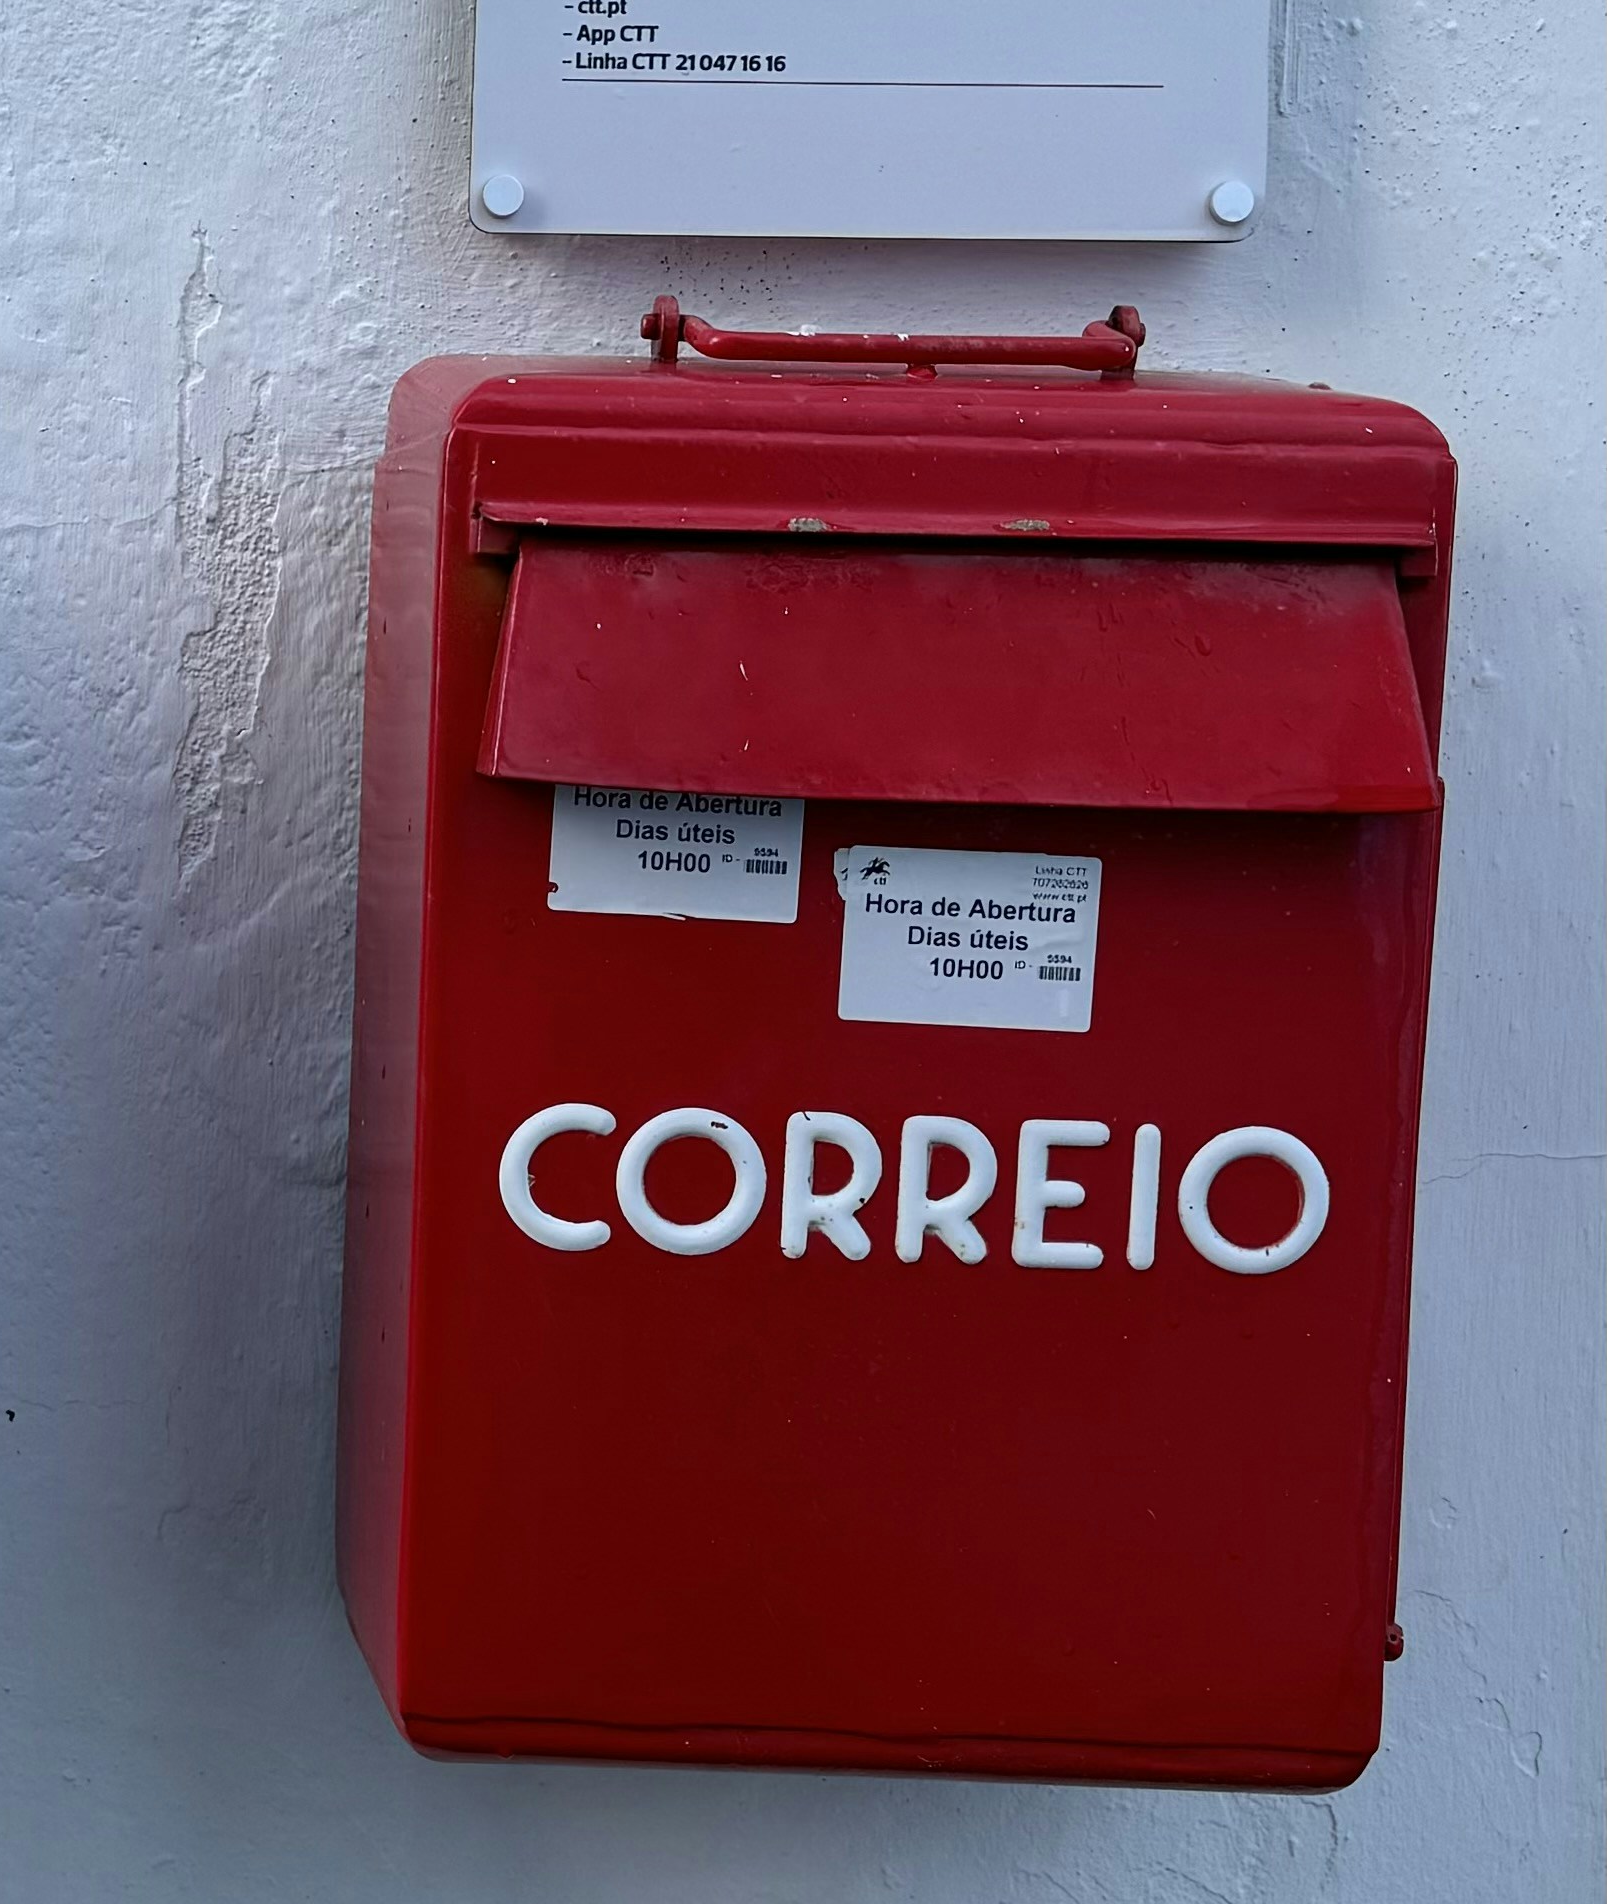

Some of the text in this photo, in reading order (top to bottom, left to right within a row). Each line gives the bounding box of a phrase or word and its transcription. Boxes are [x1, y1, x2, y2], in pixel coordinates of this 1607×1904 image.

[577, 25, 615, 45] App
[619, 25, 659, 43] CTT
[576, 52, 628, 70] Linha
[632, 53, 671, 71] CTT
[767, 55, 786, 72] 16
[574, 786, 782, 817] Hora de Abertura
[616, 819, 736, 844] Dias úteis
[638, 850, 711, 874] 10H00
[1066, 867, 1087, 876] CTT
[865, 893, 1076, 923] Hora de Abertura
[908, 926, 1029, 951] Dias úteis
[929, 957, 1004, 980] 10H00
[499, 1102, 1331, 1275] CORREIO
